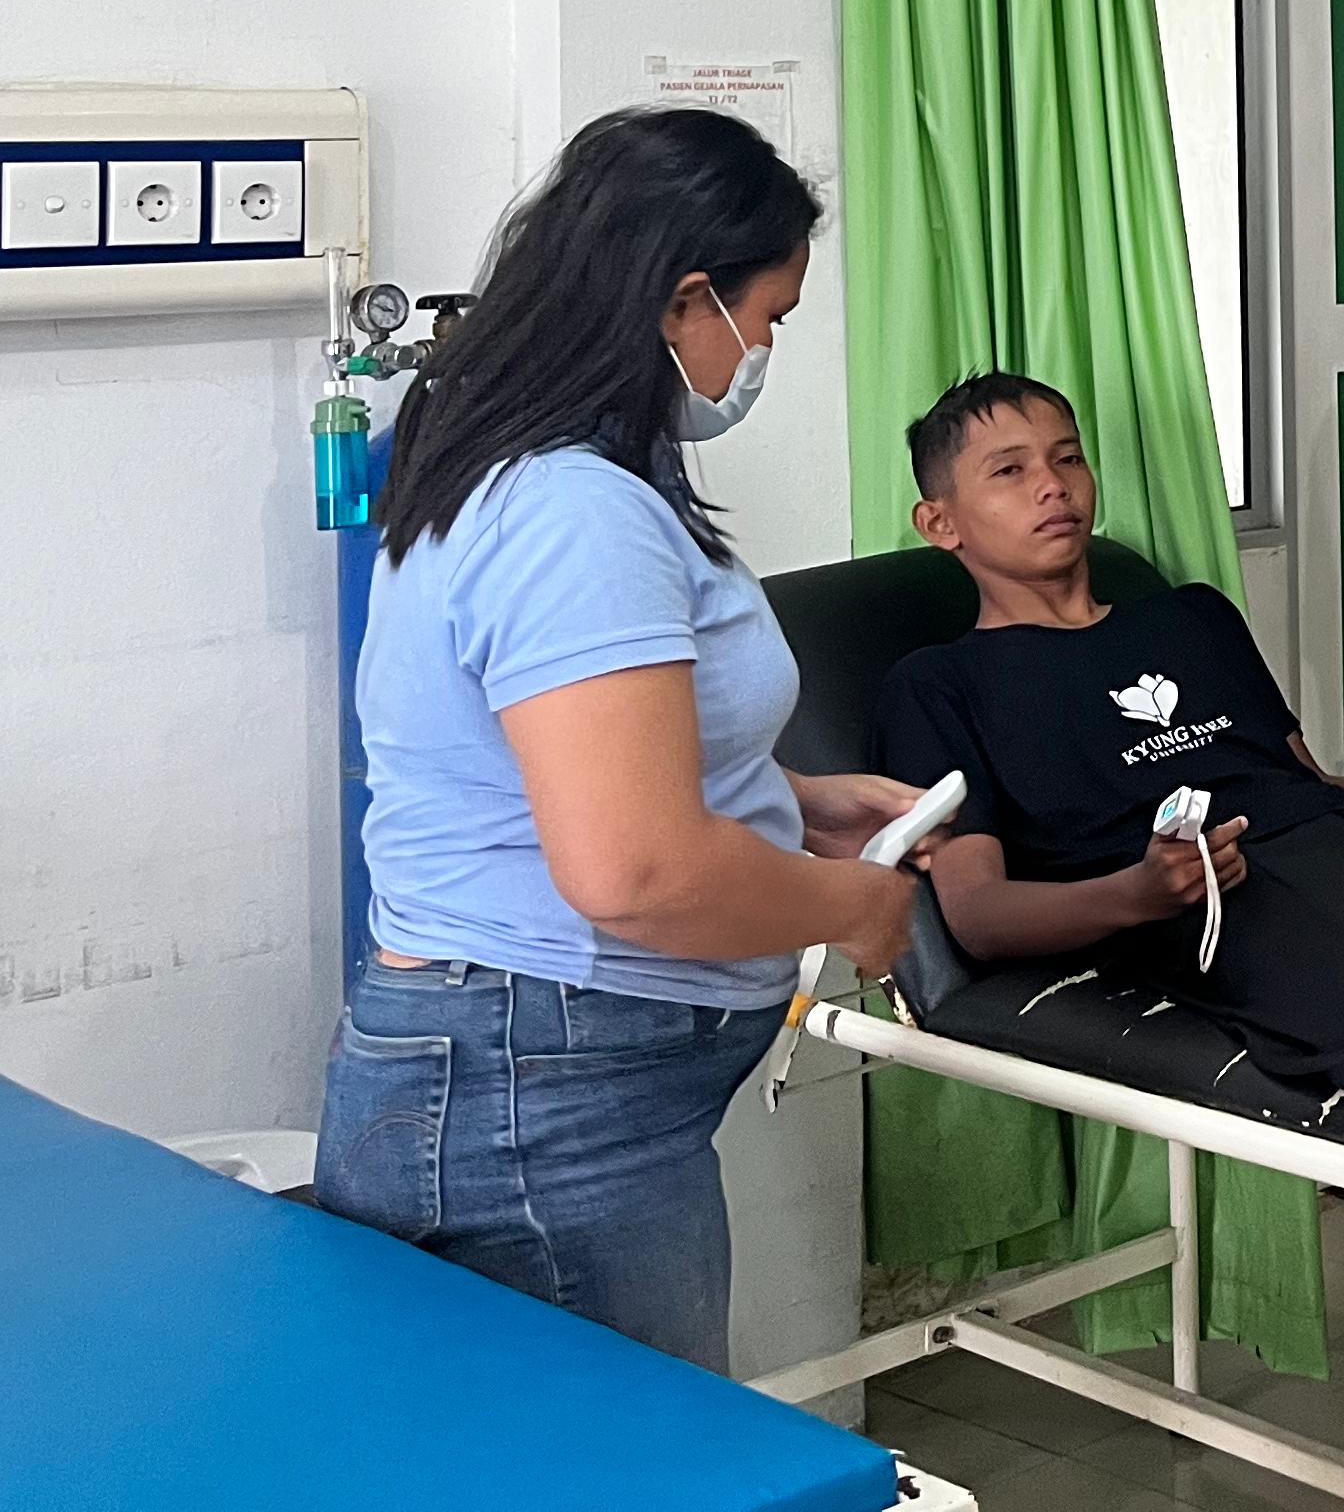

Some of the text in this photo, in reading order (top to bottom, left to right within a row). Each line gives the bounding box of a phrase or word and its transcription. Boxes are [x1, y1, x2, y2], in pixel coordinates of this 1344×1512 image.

[660, 82, 784, 91] PASIEN GEJALA PERNAPASAN
[1121, 726, 1190, 766] KYUNG
